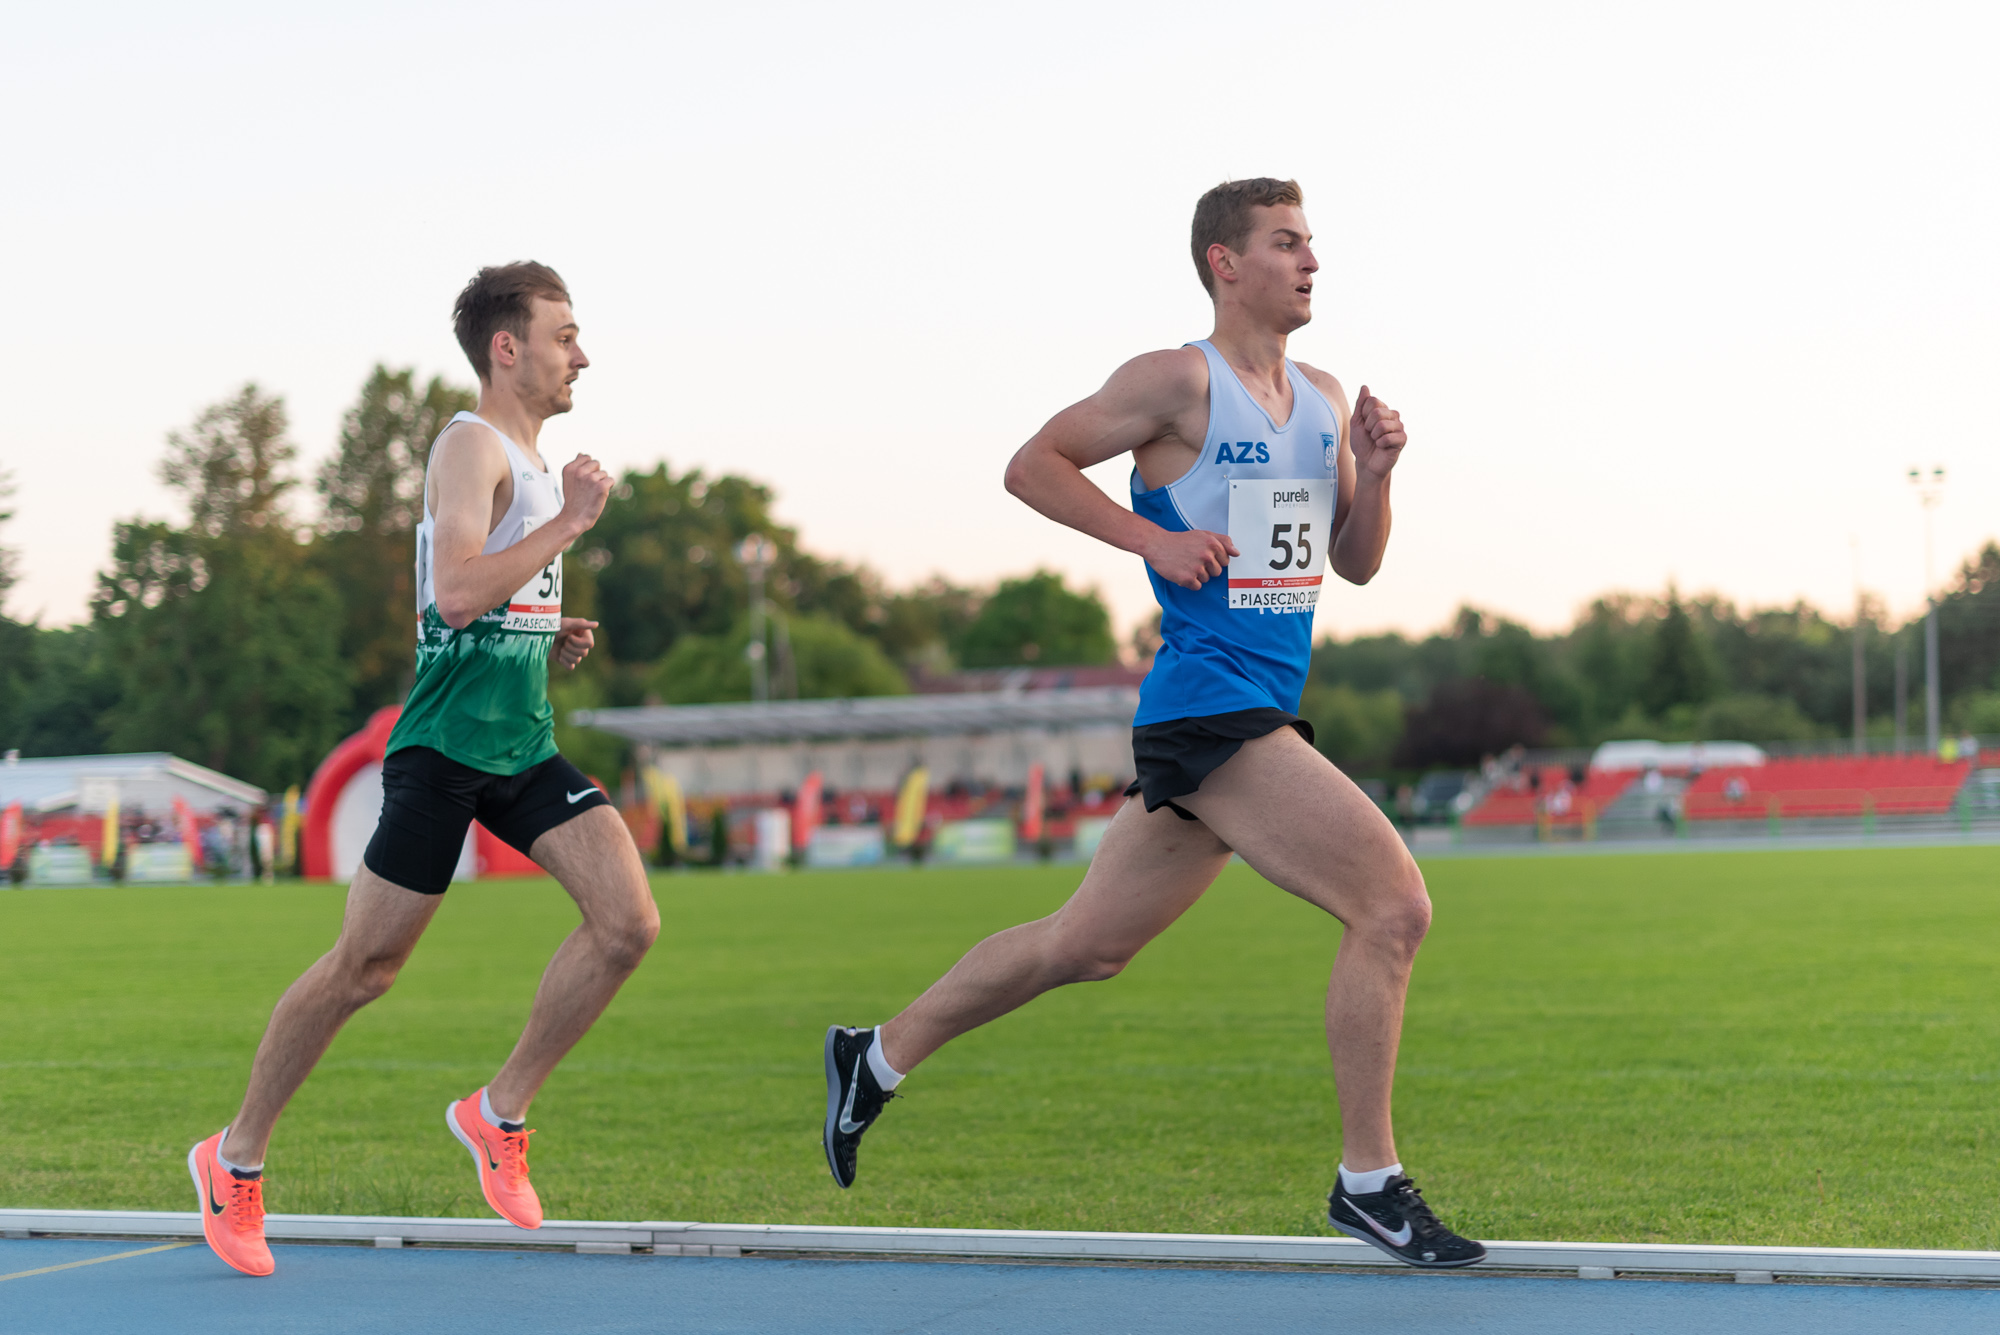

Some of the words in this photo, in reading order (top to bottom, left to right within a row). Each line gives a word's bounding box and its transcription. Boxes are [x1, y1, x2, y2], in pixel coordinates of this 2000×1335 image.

[1215, 441, 1270, 465] AZS
[1273, 488, 1309, 508] purella
[1269, 523, 1312, 571] 55
[1240, 591, 1306, 606] PIASECZNO
[513, 617, 556, 630] PIASECZNO
